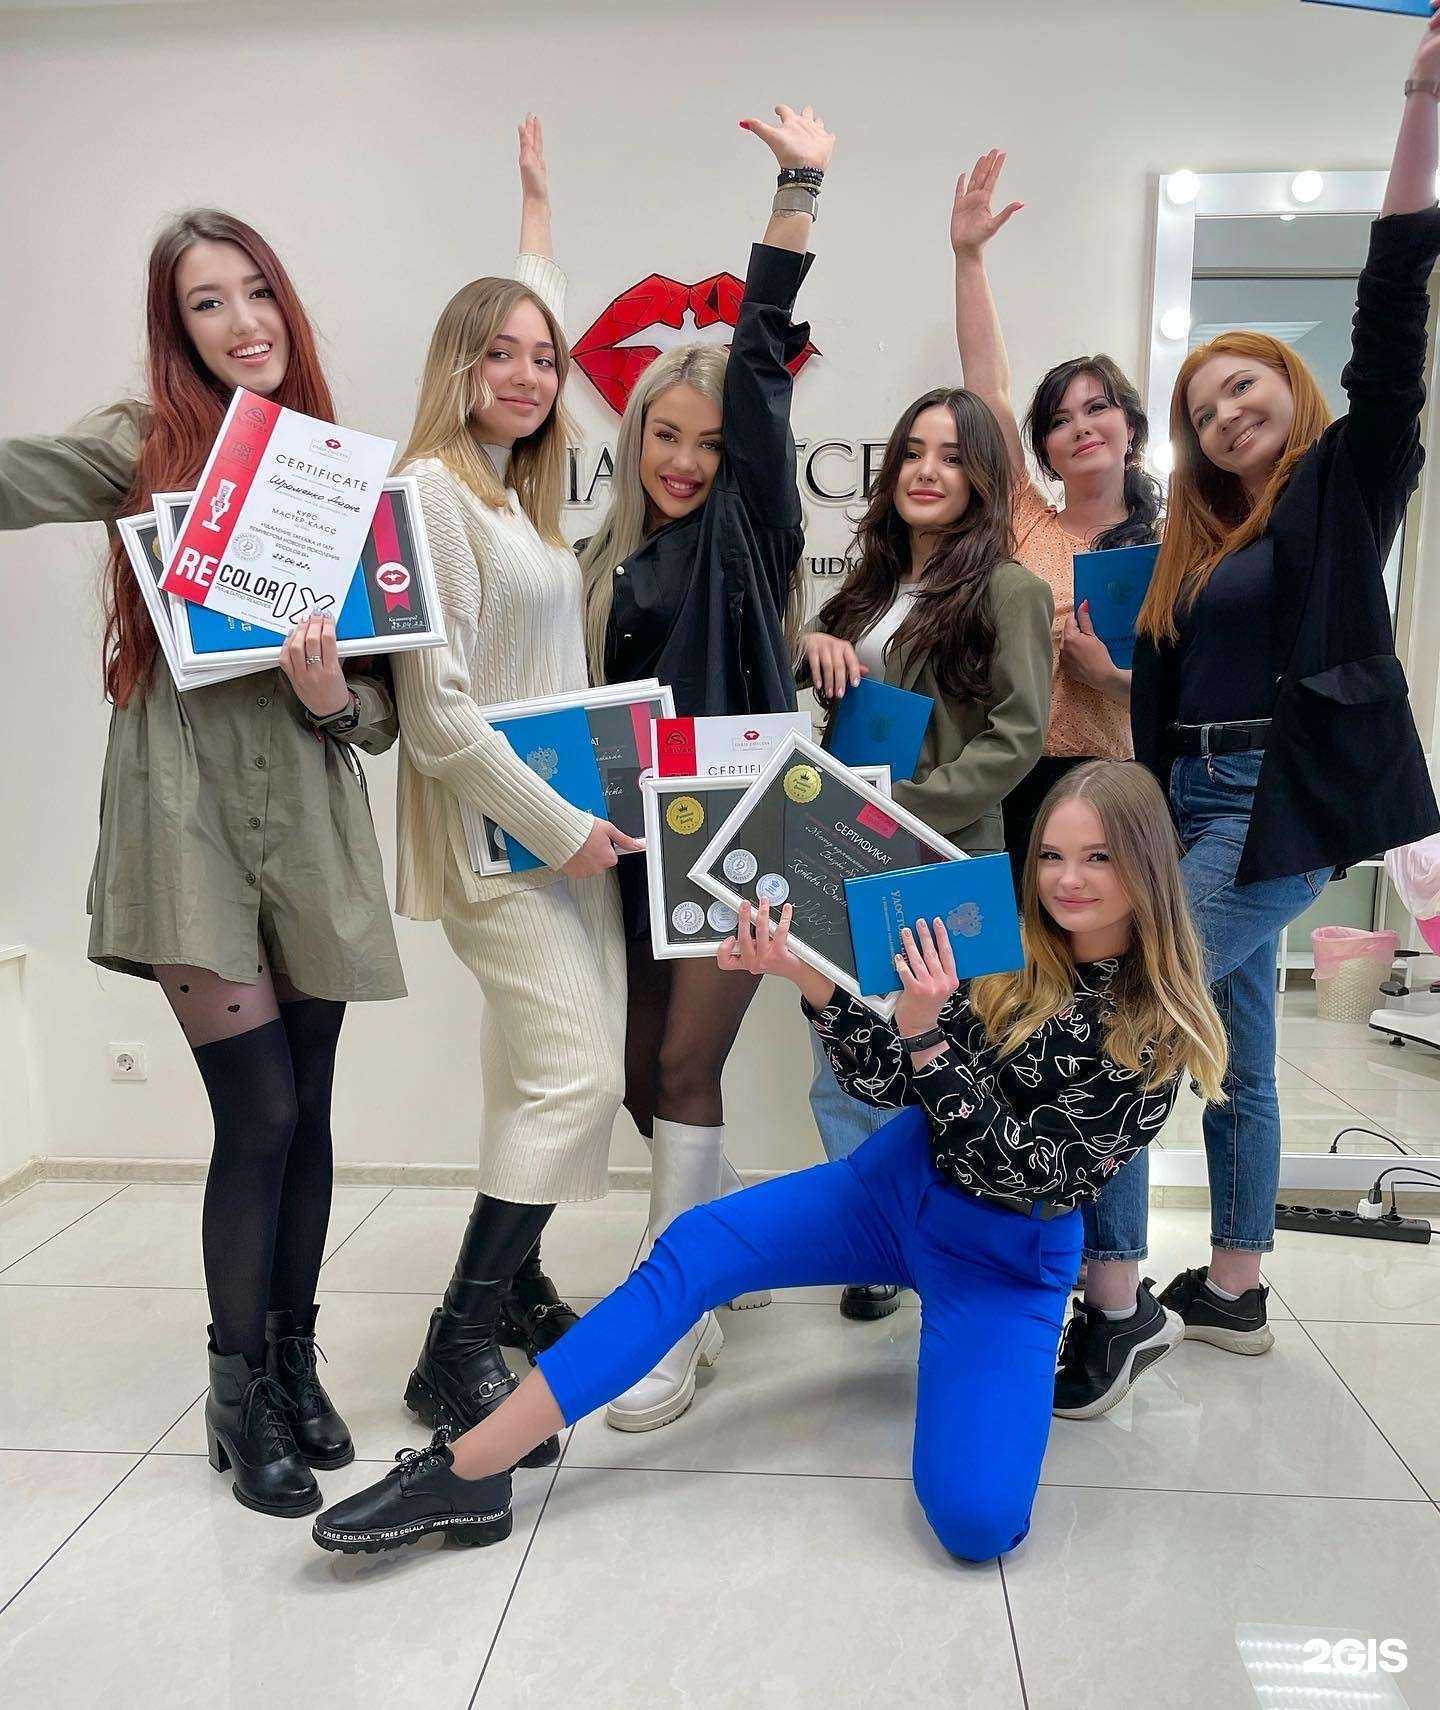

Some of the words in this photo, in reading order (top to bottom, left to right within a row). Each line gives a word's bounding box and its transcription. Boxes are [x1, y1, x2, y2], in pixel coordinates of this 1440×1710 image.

[275, 454, 368, 492] CERTIFICATE
[272, 508, 337, 535] МАСТЕР-КЛАСС
[297, 509, 318, 521] КУРС
[175, 546, 220, 588] RE
[219, 564, 280, 601] COLOR
[708, 764, 762, 776] CERTIFI
[834, 821, 892, 865] СЕРТИФИКАТ
[323, 1530, 341, 1540] FREE
[381, 1528, 399, 1539] FREE
[433, 1519, 450, 1528] FREE
